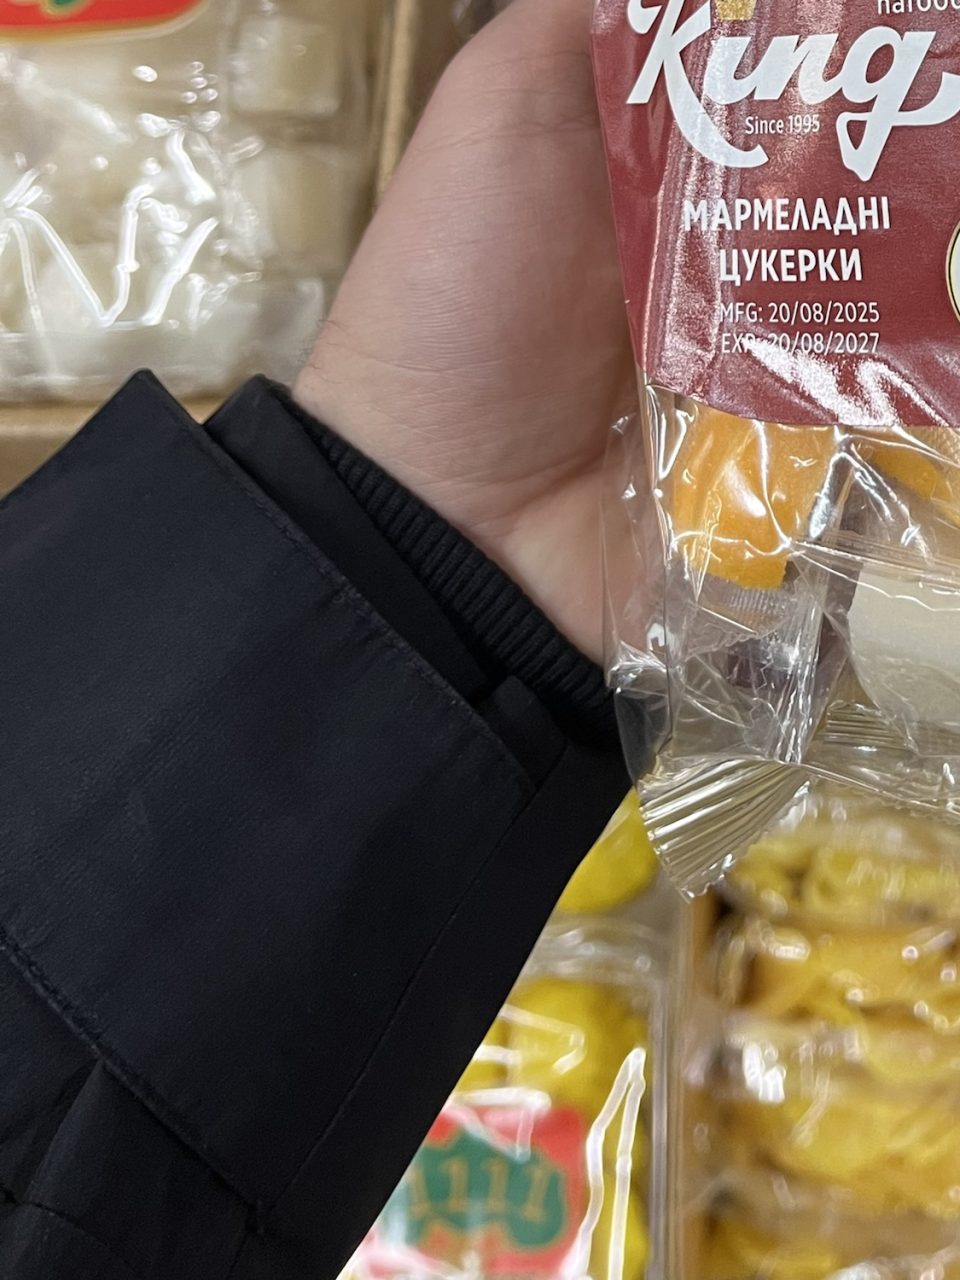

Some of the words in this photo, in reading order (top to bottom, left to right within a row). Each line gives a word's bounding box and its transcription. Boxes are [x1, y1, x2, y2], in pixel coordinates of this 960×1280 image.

[744, 116, 784, 136] Since
[787, 114, 821, 135] 1995
[684, 195, 891, 236] МАРМЕЛАДНІ
[719, 248, 864, 286] ЦУКЕРКИ
[720, 301, 763, 324] MFG:
[768, 300, 880, 326] 20/08/2025
[721, 332, 763, 354] EXP
[768, 330, 880, 357] 20/08/2027
